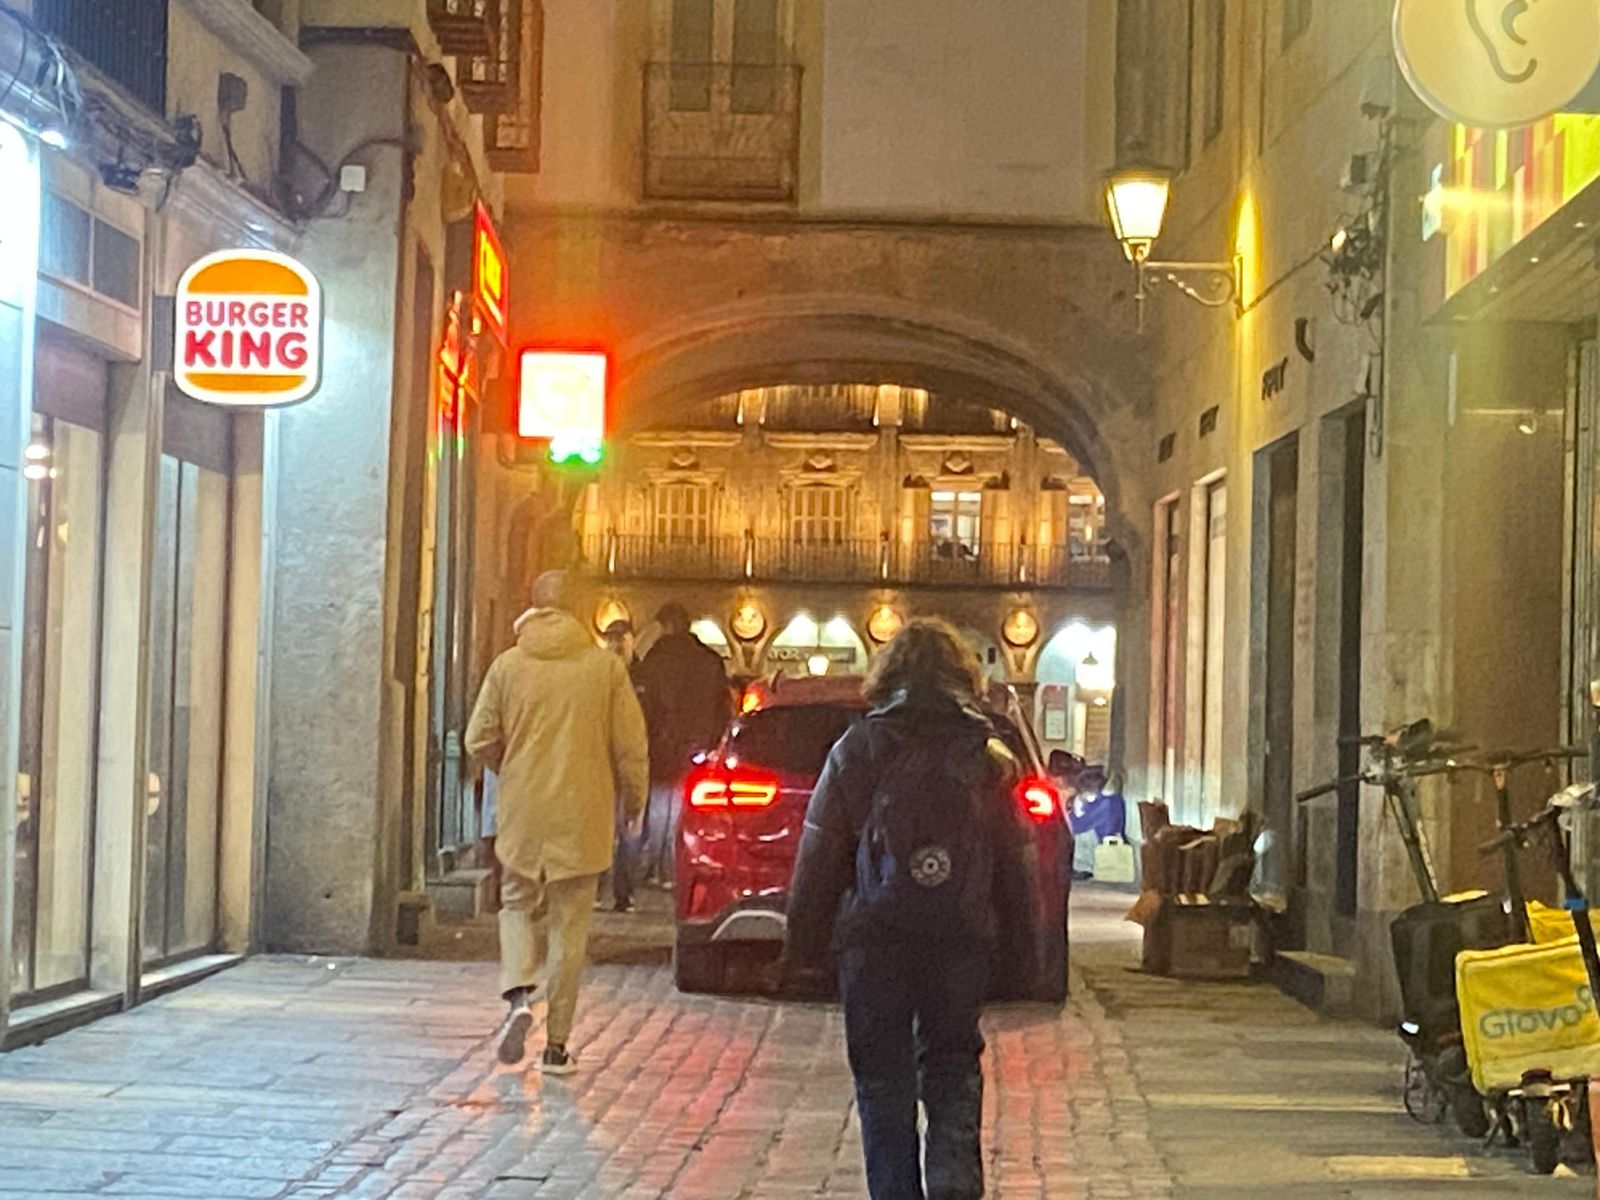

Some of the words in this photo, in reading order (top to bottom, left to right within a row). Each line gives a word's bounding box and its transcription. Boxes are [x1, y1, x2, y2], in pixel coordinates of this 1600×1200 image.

[185, 301, 308, 328] BURGER
[184, 330, 308, 369] KING
[1479, 1004, 1581, 1039] Glovo
